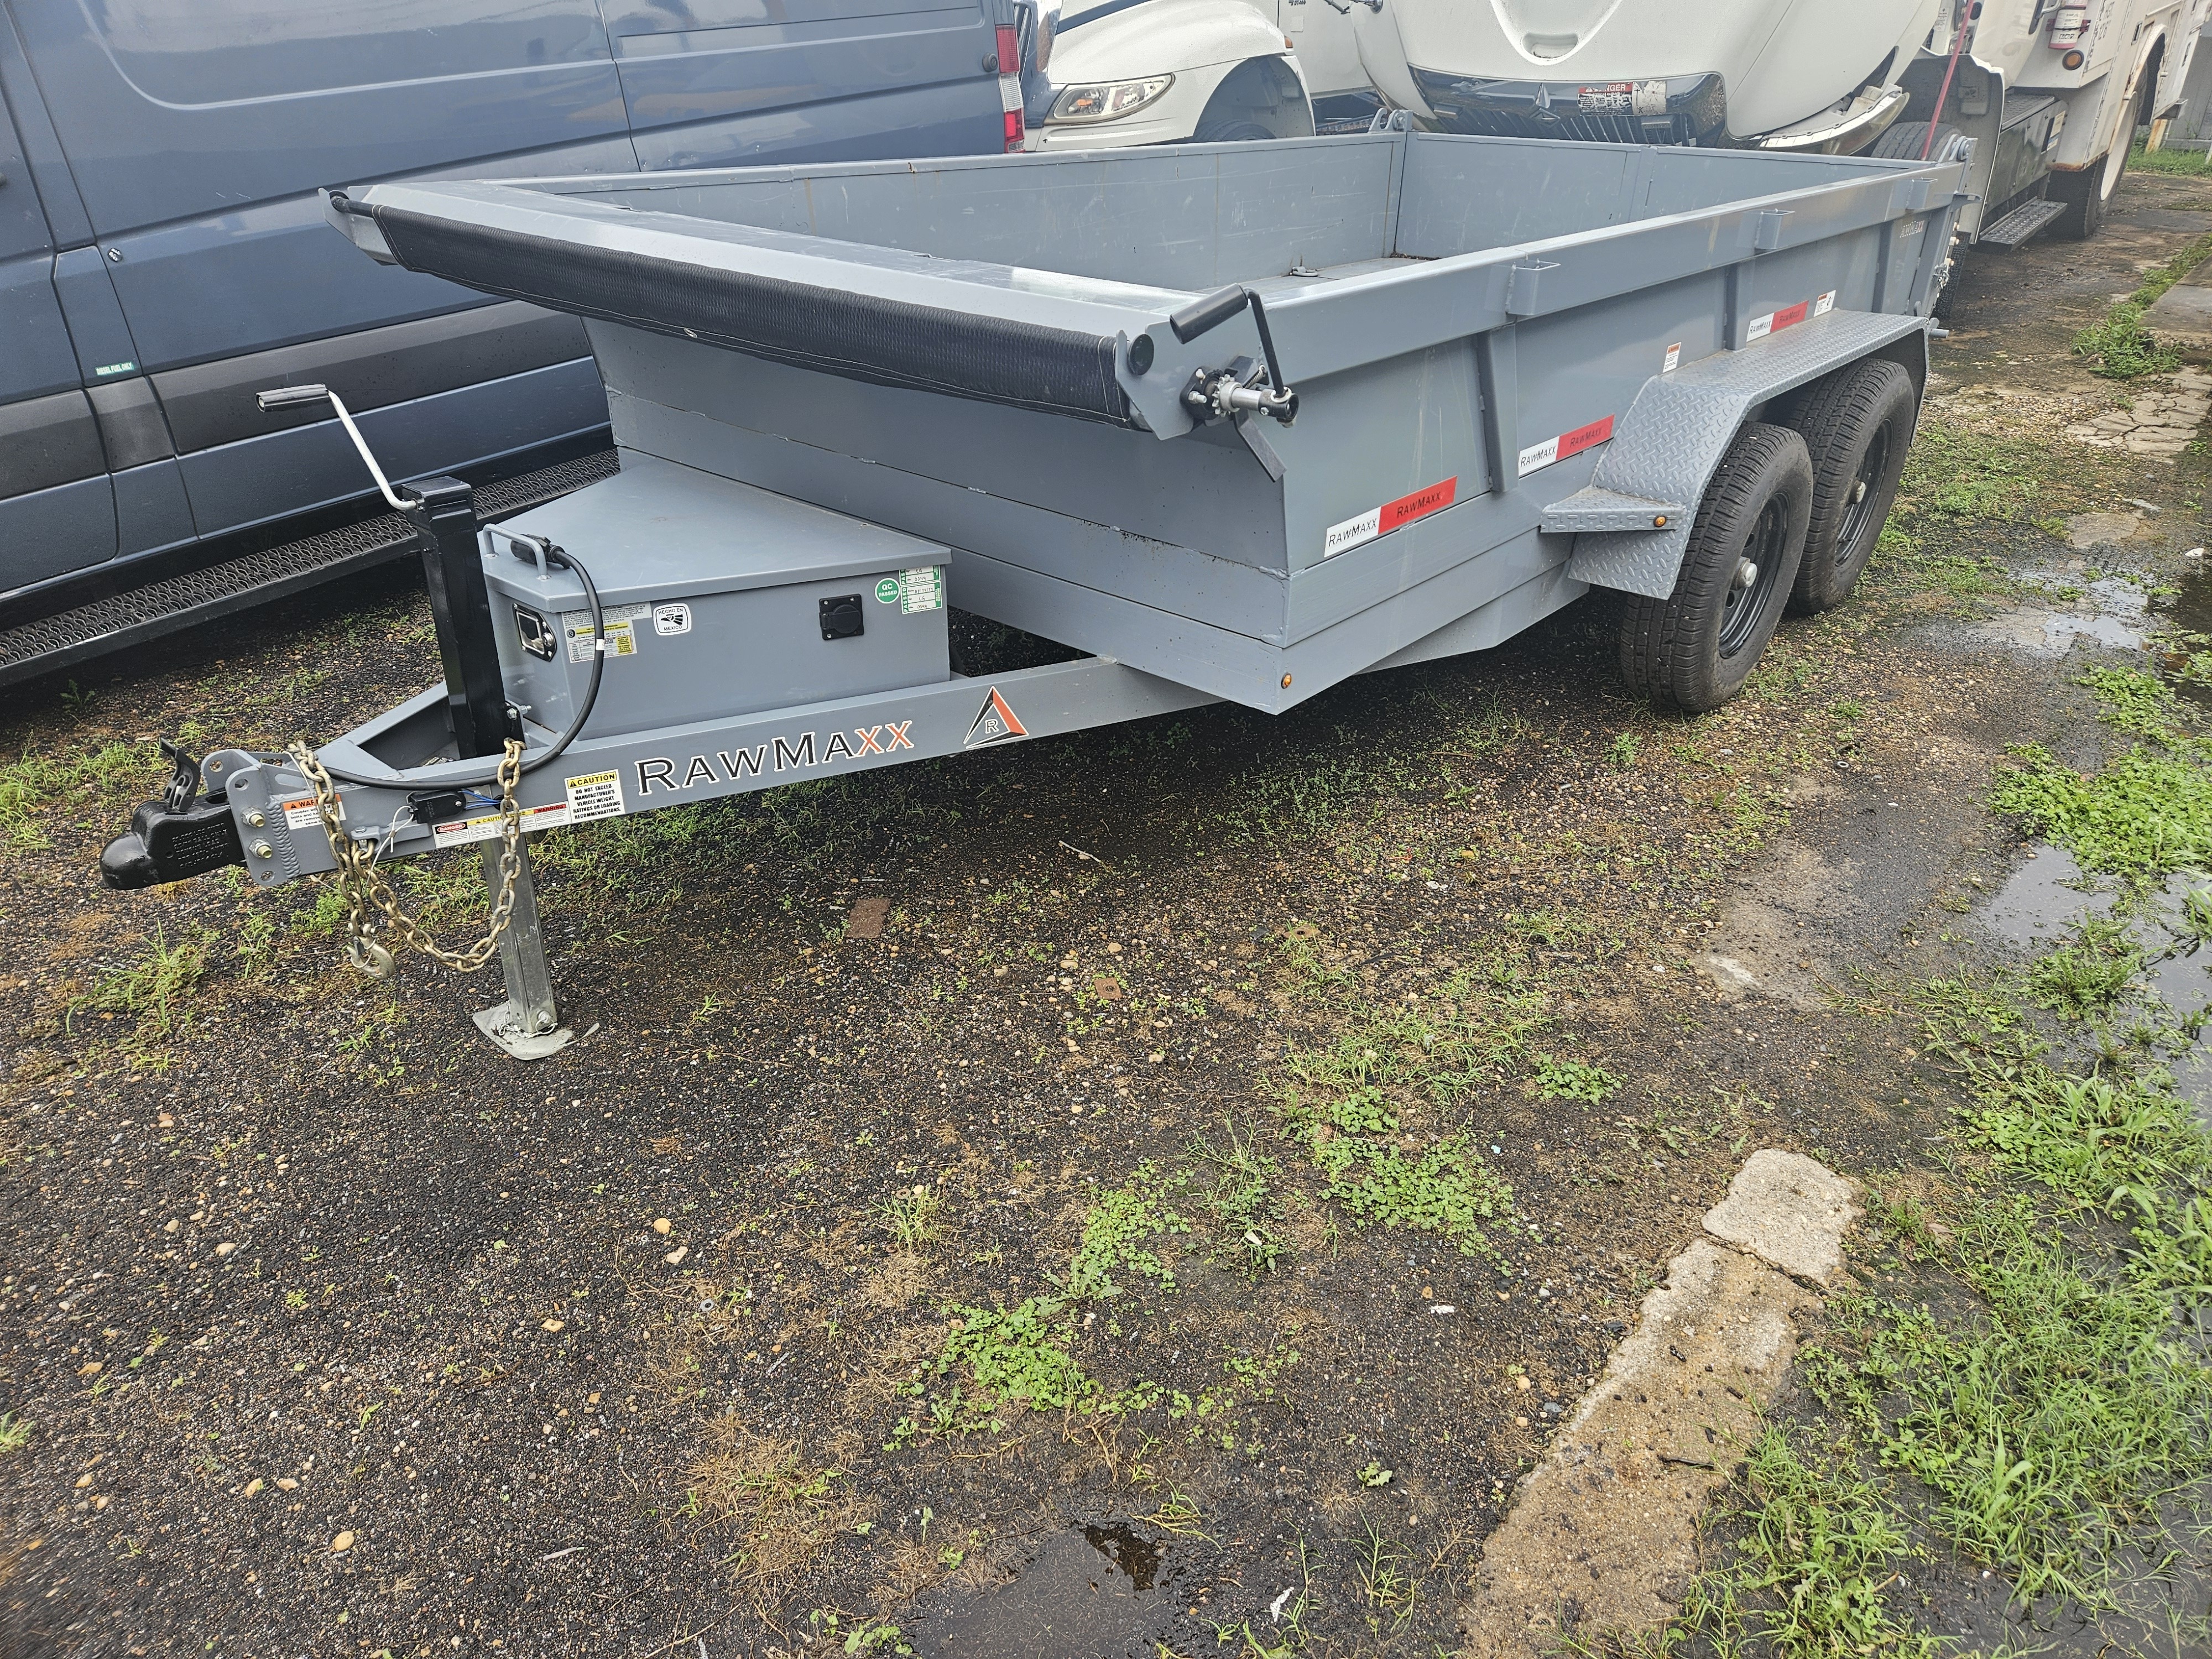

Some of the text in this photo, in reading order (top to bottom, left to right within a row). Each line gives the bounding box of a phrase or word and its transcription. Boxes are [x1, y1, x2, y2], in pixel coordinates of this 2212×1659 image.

[111, 364, 122, 373] FUEL
[1328, 491, 1441, 547] RAWMAXX RAWMAXX
[577, 774, 615, 785] CAUTION
[575, 789, 615, 800] MANUFACTURER'S
[538, 804, 564, 812] WARNING
